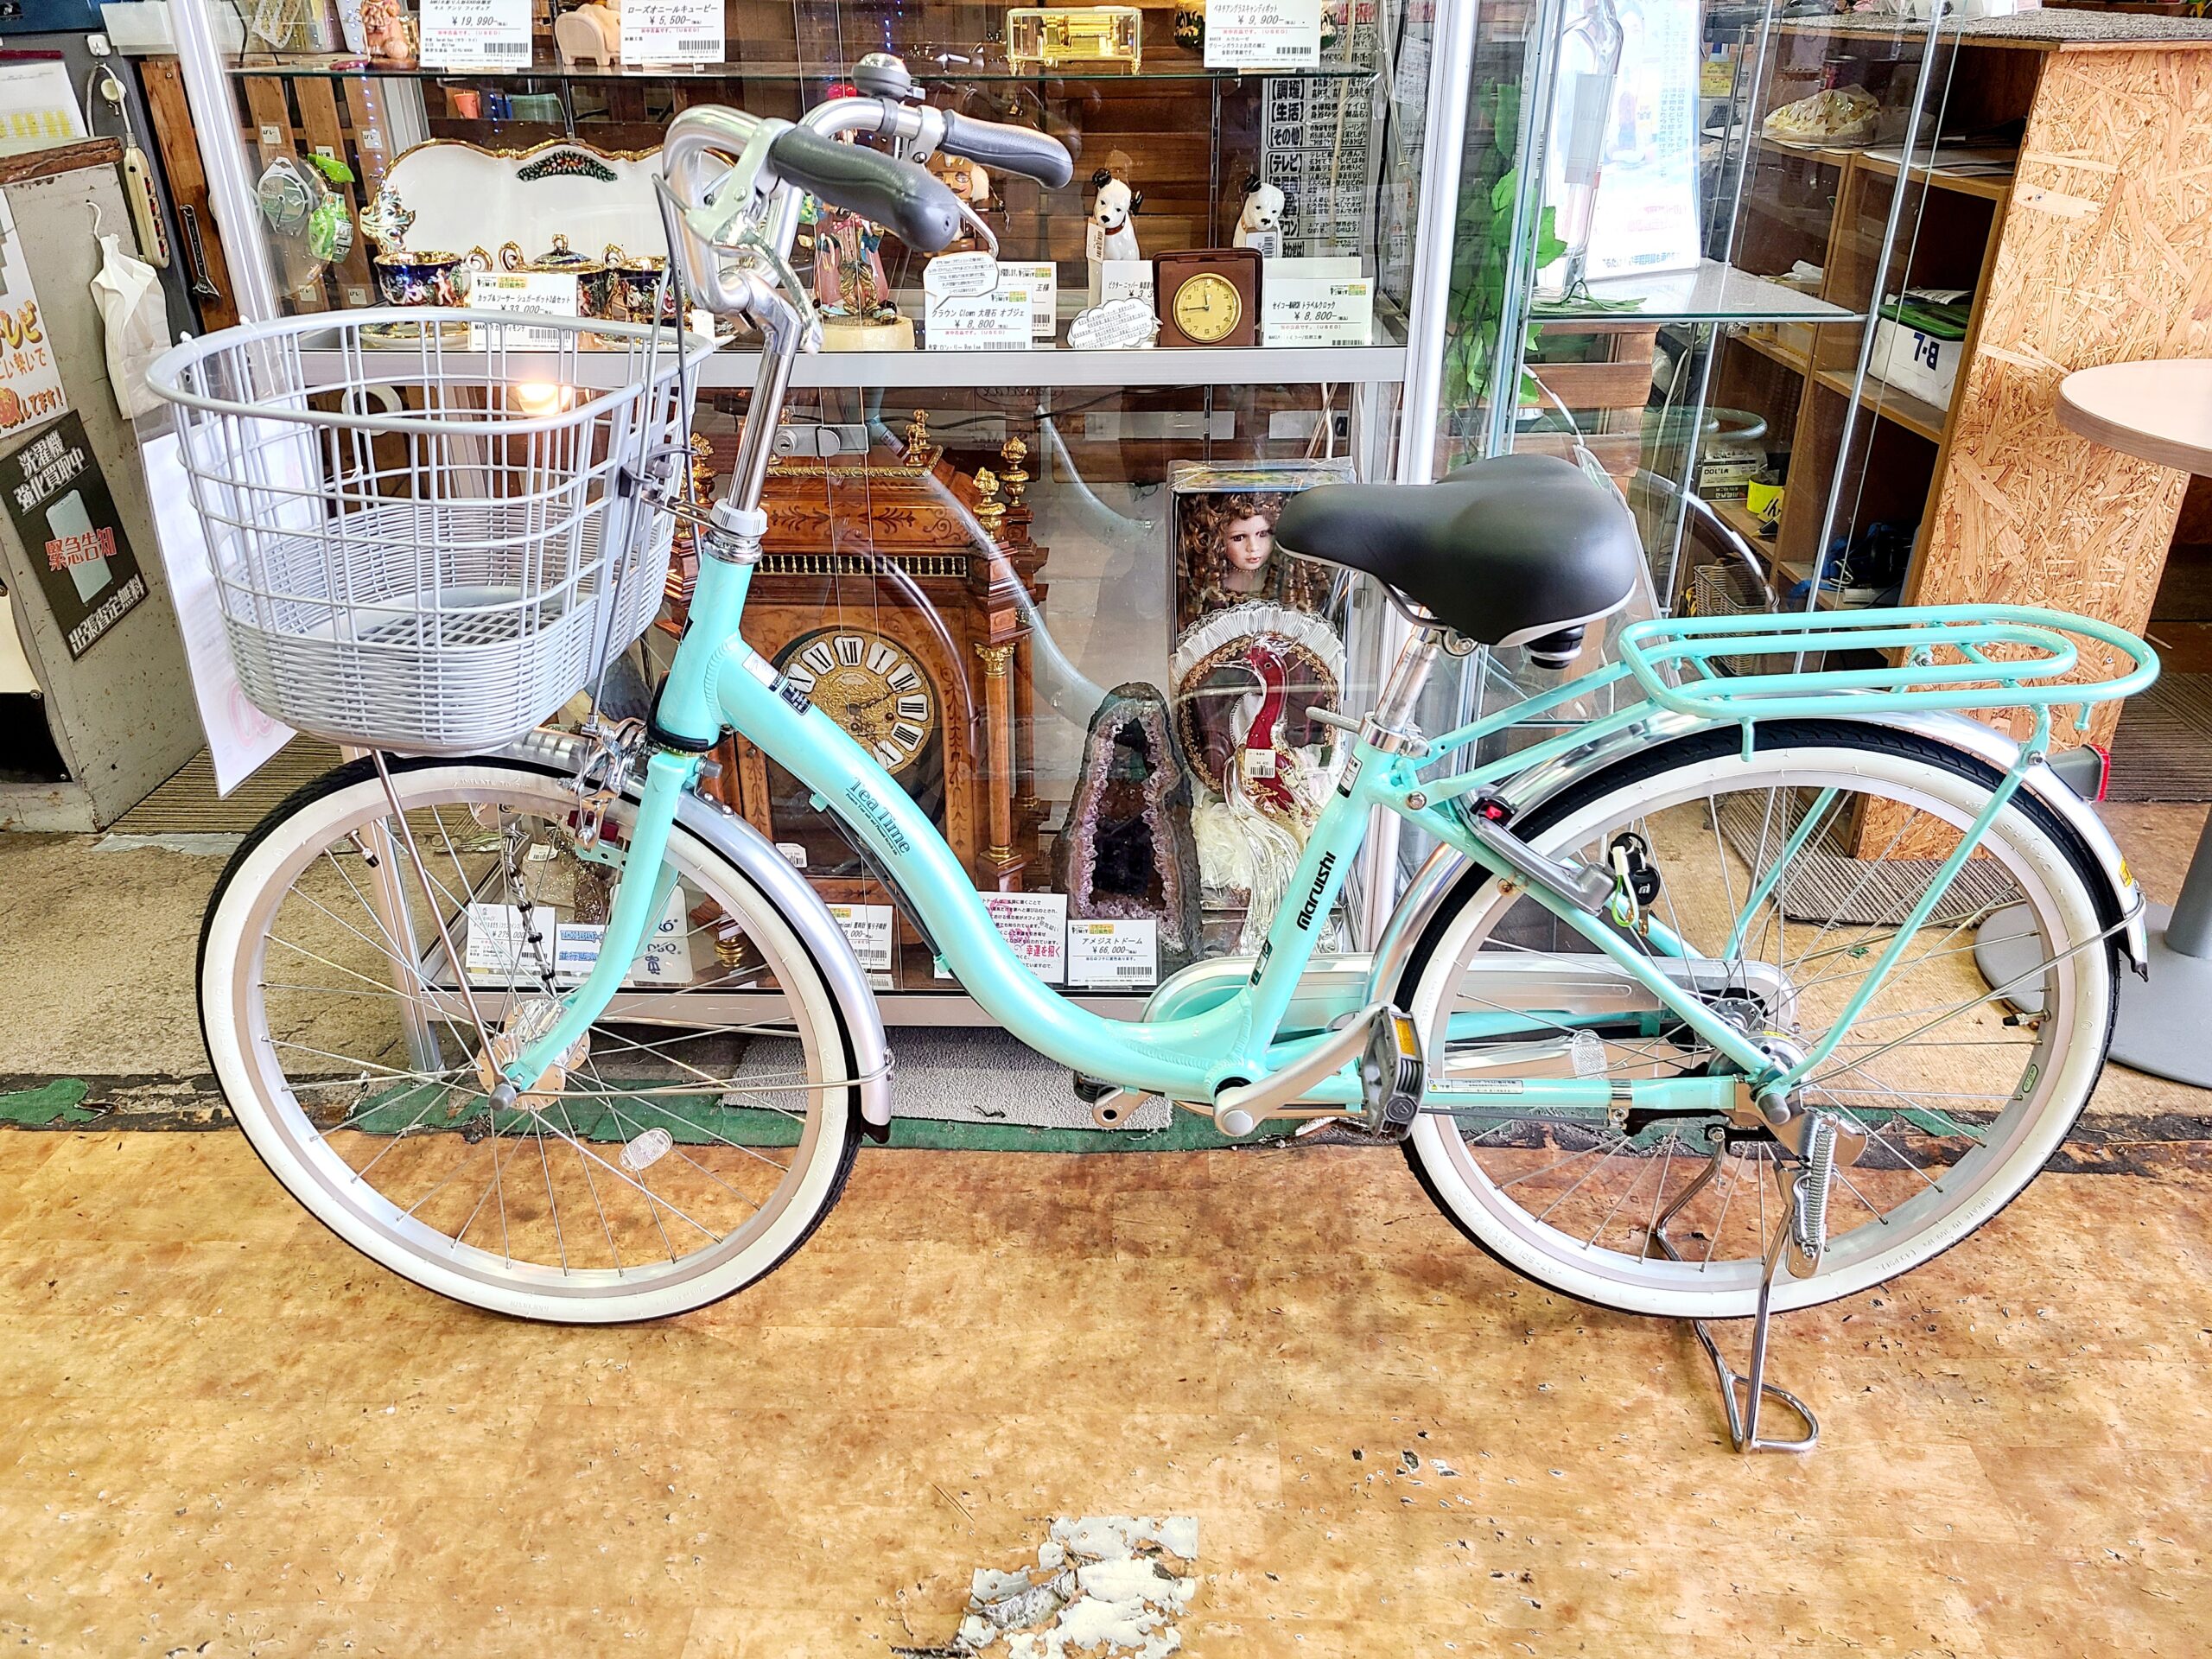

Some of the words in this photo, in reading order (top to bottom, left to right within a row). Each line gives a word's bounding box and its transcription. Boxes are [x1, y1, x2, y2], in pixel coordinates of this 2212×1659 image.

[628, 4, 718, 14] ローズオニールキューピー
[1271, 101, 1305, 123] 【生活】
[1269, 125, 1304, 147] 【その他】
[1269, 153, 1303, 174] 【テレビ】
[1036, 283, 1050, 292] 王様
[931, 308, 957, 318] クラウン
[959, 308, 976, 317] Clown
[977, 308, 997, 317] 大理石
[1000, 308, 1025, 317] オブジェ
[17, 429, 66, 477] 洗濯機
[13, 446, 86, 513] 強化買取中
[45, 526, 118, 572] 緊急告知
[67, 574, 144, 655] 出張査定無料
[849, 776, 879, 811] Tea
[877, 806, 911, 853] Time
[1027, 944, 1060, 957] 幸運を招く
